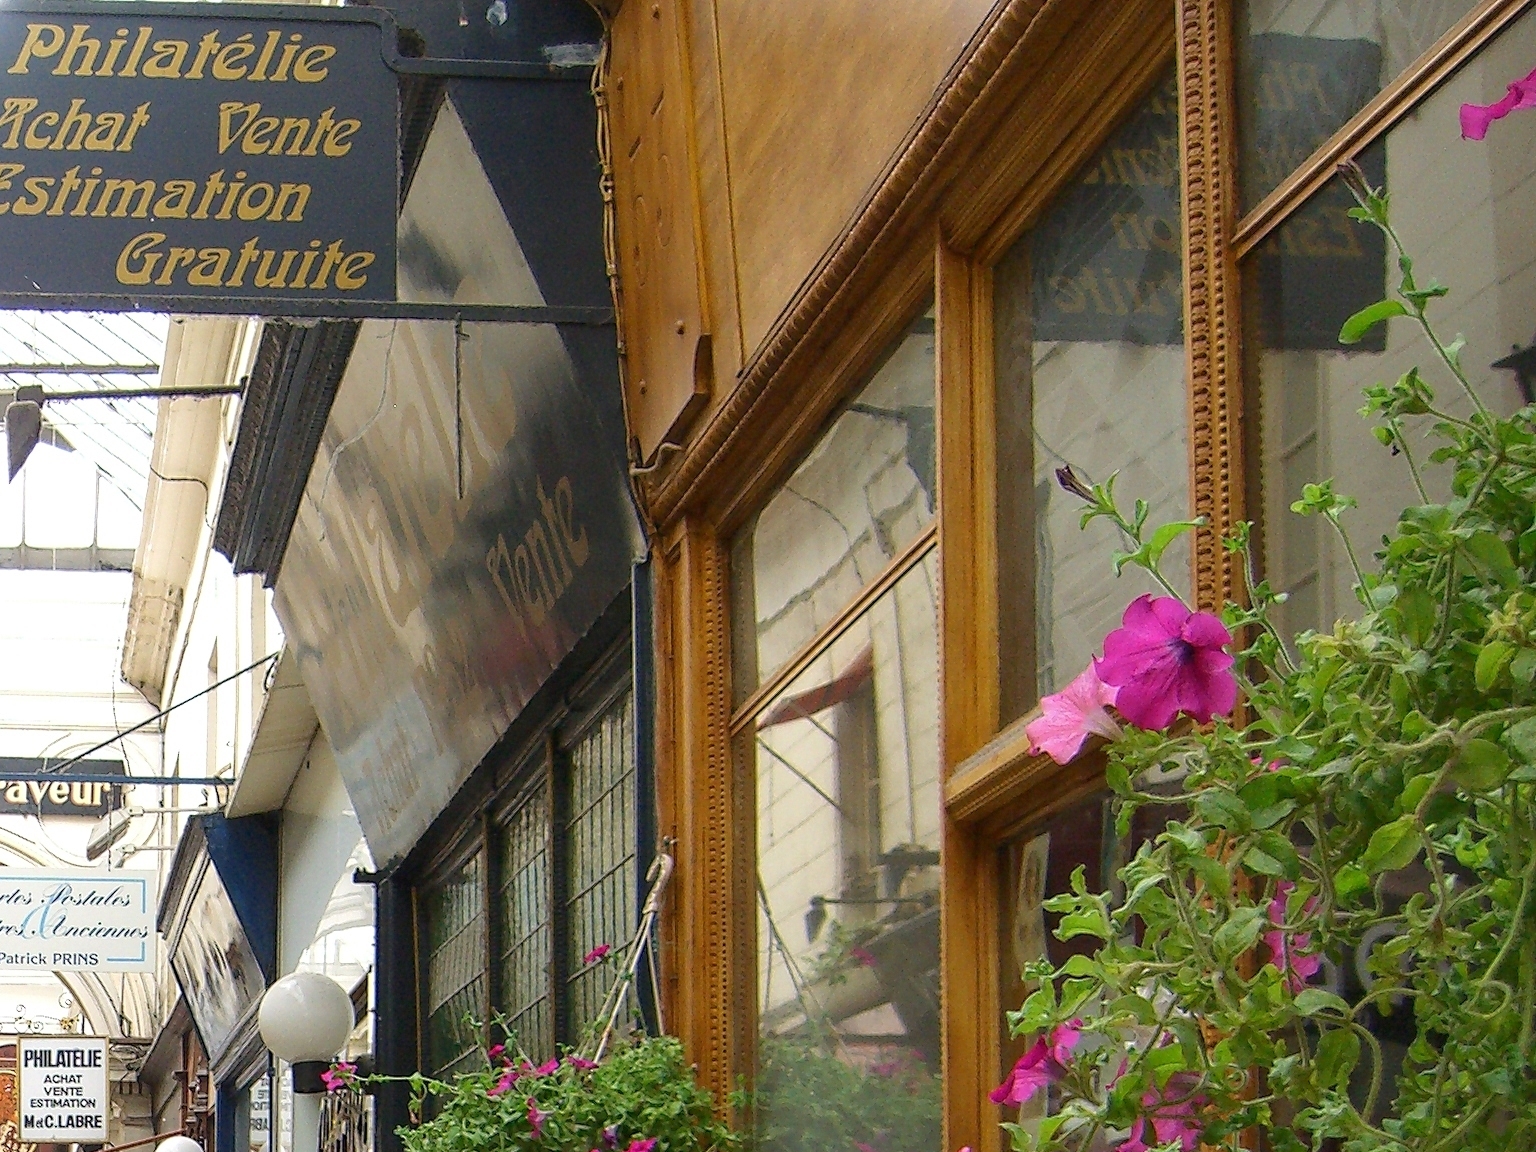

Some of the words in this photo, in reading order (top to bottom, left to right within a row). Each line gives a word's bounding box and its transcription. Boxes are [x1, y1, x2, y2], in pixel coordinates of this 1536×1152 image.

[7, 23, 338, 84] Philatélie
[218, 101, 362, 157] Vente
[115, 232, 376, 291] Gratuite
[41, 882, 130, 907] Postales
[30, 908, 148, 939] Anciennes
[53, 953, 99, 966] PRINS
[43, 1074, 83, 1085] ACHAT
[43, 1086, 84, 1097] VENTE
[30, 1098, 96, 1109] ESTIMATION
